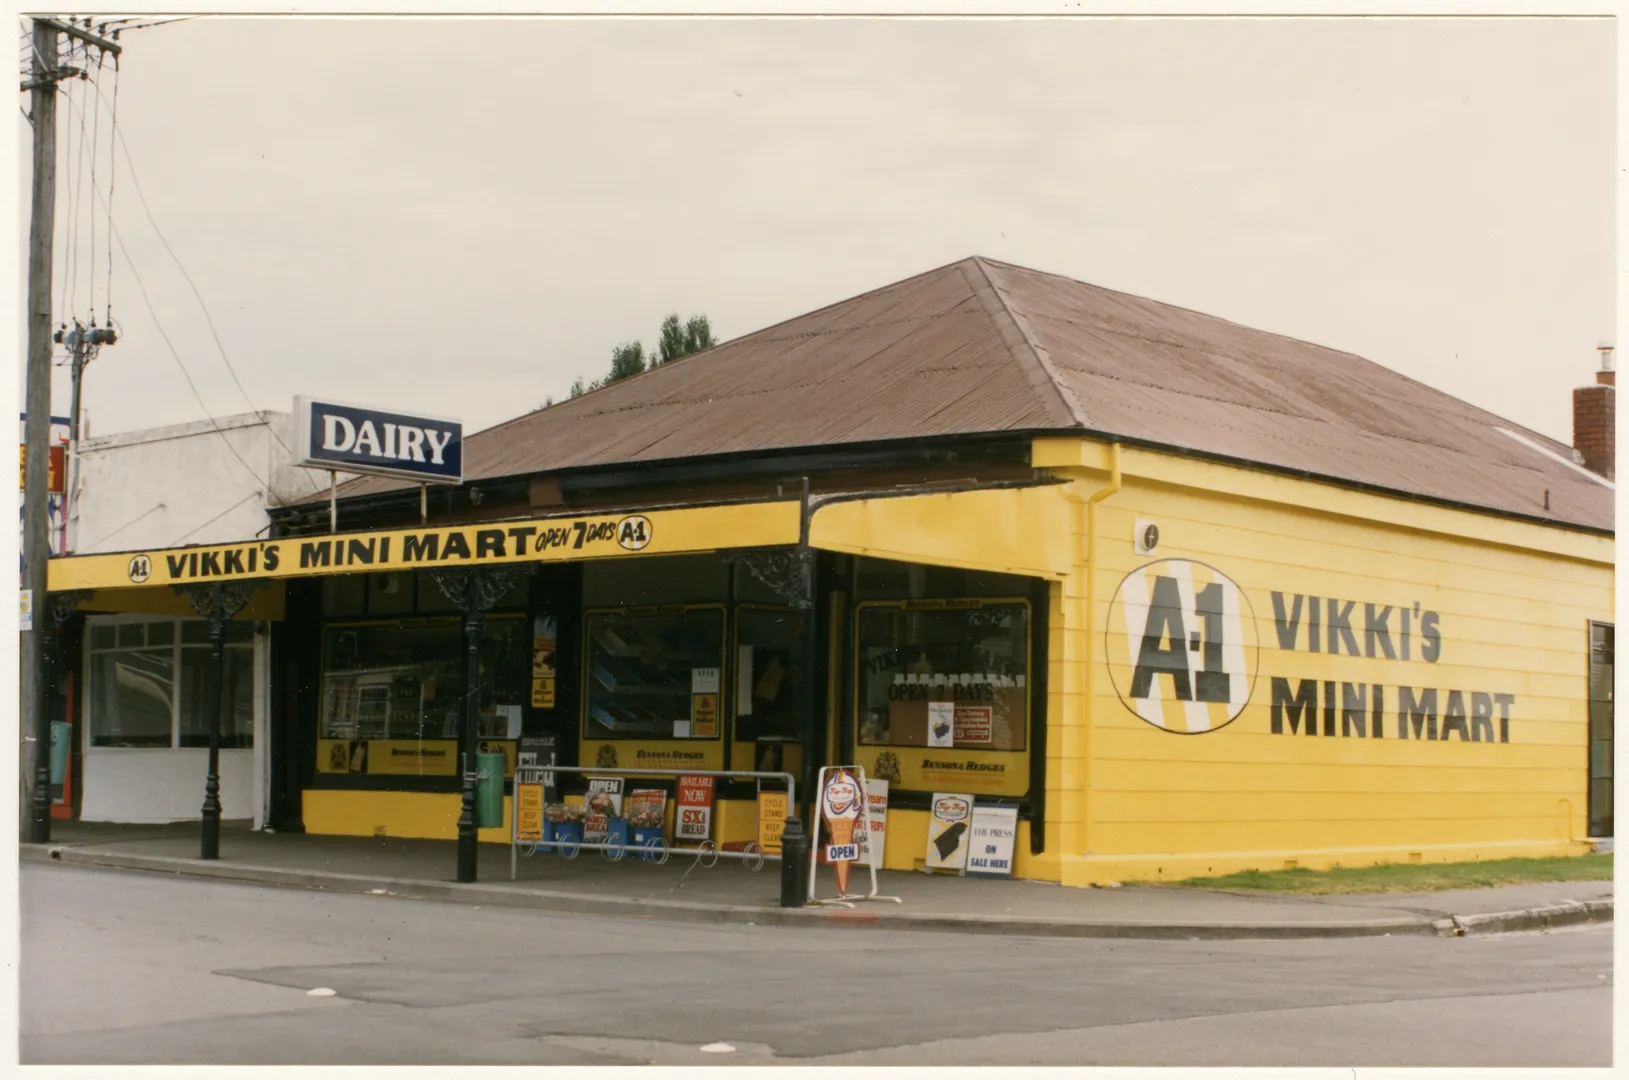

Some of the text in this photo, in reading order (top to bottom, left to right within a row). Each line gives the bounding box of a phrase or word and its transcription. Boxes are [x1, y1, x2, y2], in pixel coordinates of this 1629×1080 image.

[322, 413, 452, 465] DAIRY
[166, 521, 616, 579] VIKKI'S MINI MART OPEN 7 DAYS
[1270, 590, 1442, 663] VIKKI'S
[887, 683, 994, 702] OPEN 7 DAYS
[1270, 676, 1516, 744] MINI MART
[589, 779, 619, 793] OPEN
[679, 776, 713, 787] AVAILABLE
[683, 788, 707, 803] NOW
[763, 808, 783, 818] STAND
[937, 802, 966, 812] Tip-Top
[681, 823, 706, 835] BREAD
[765, 823, 781, 832] KEEP
[973, 827, 1013, 838] THE PRESS
[830, 845, 855, 860] OPEN
[985, 844, 997, 855] ON
[970, 857, 1009, 869] SALE HERE
